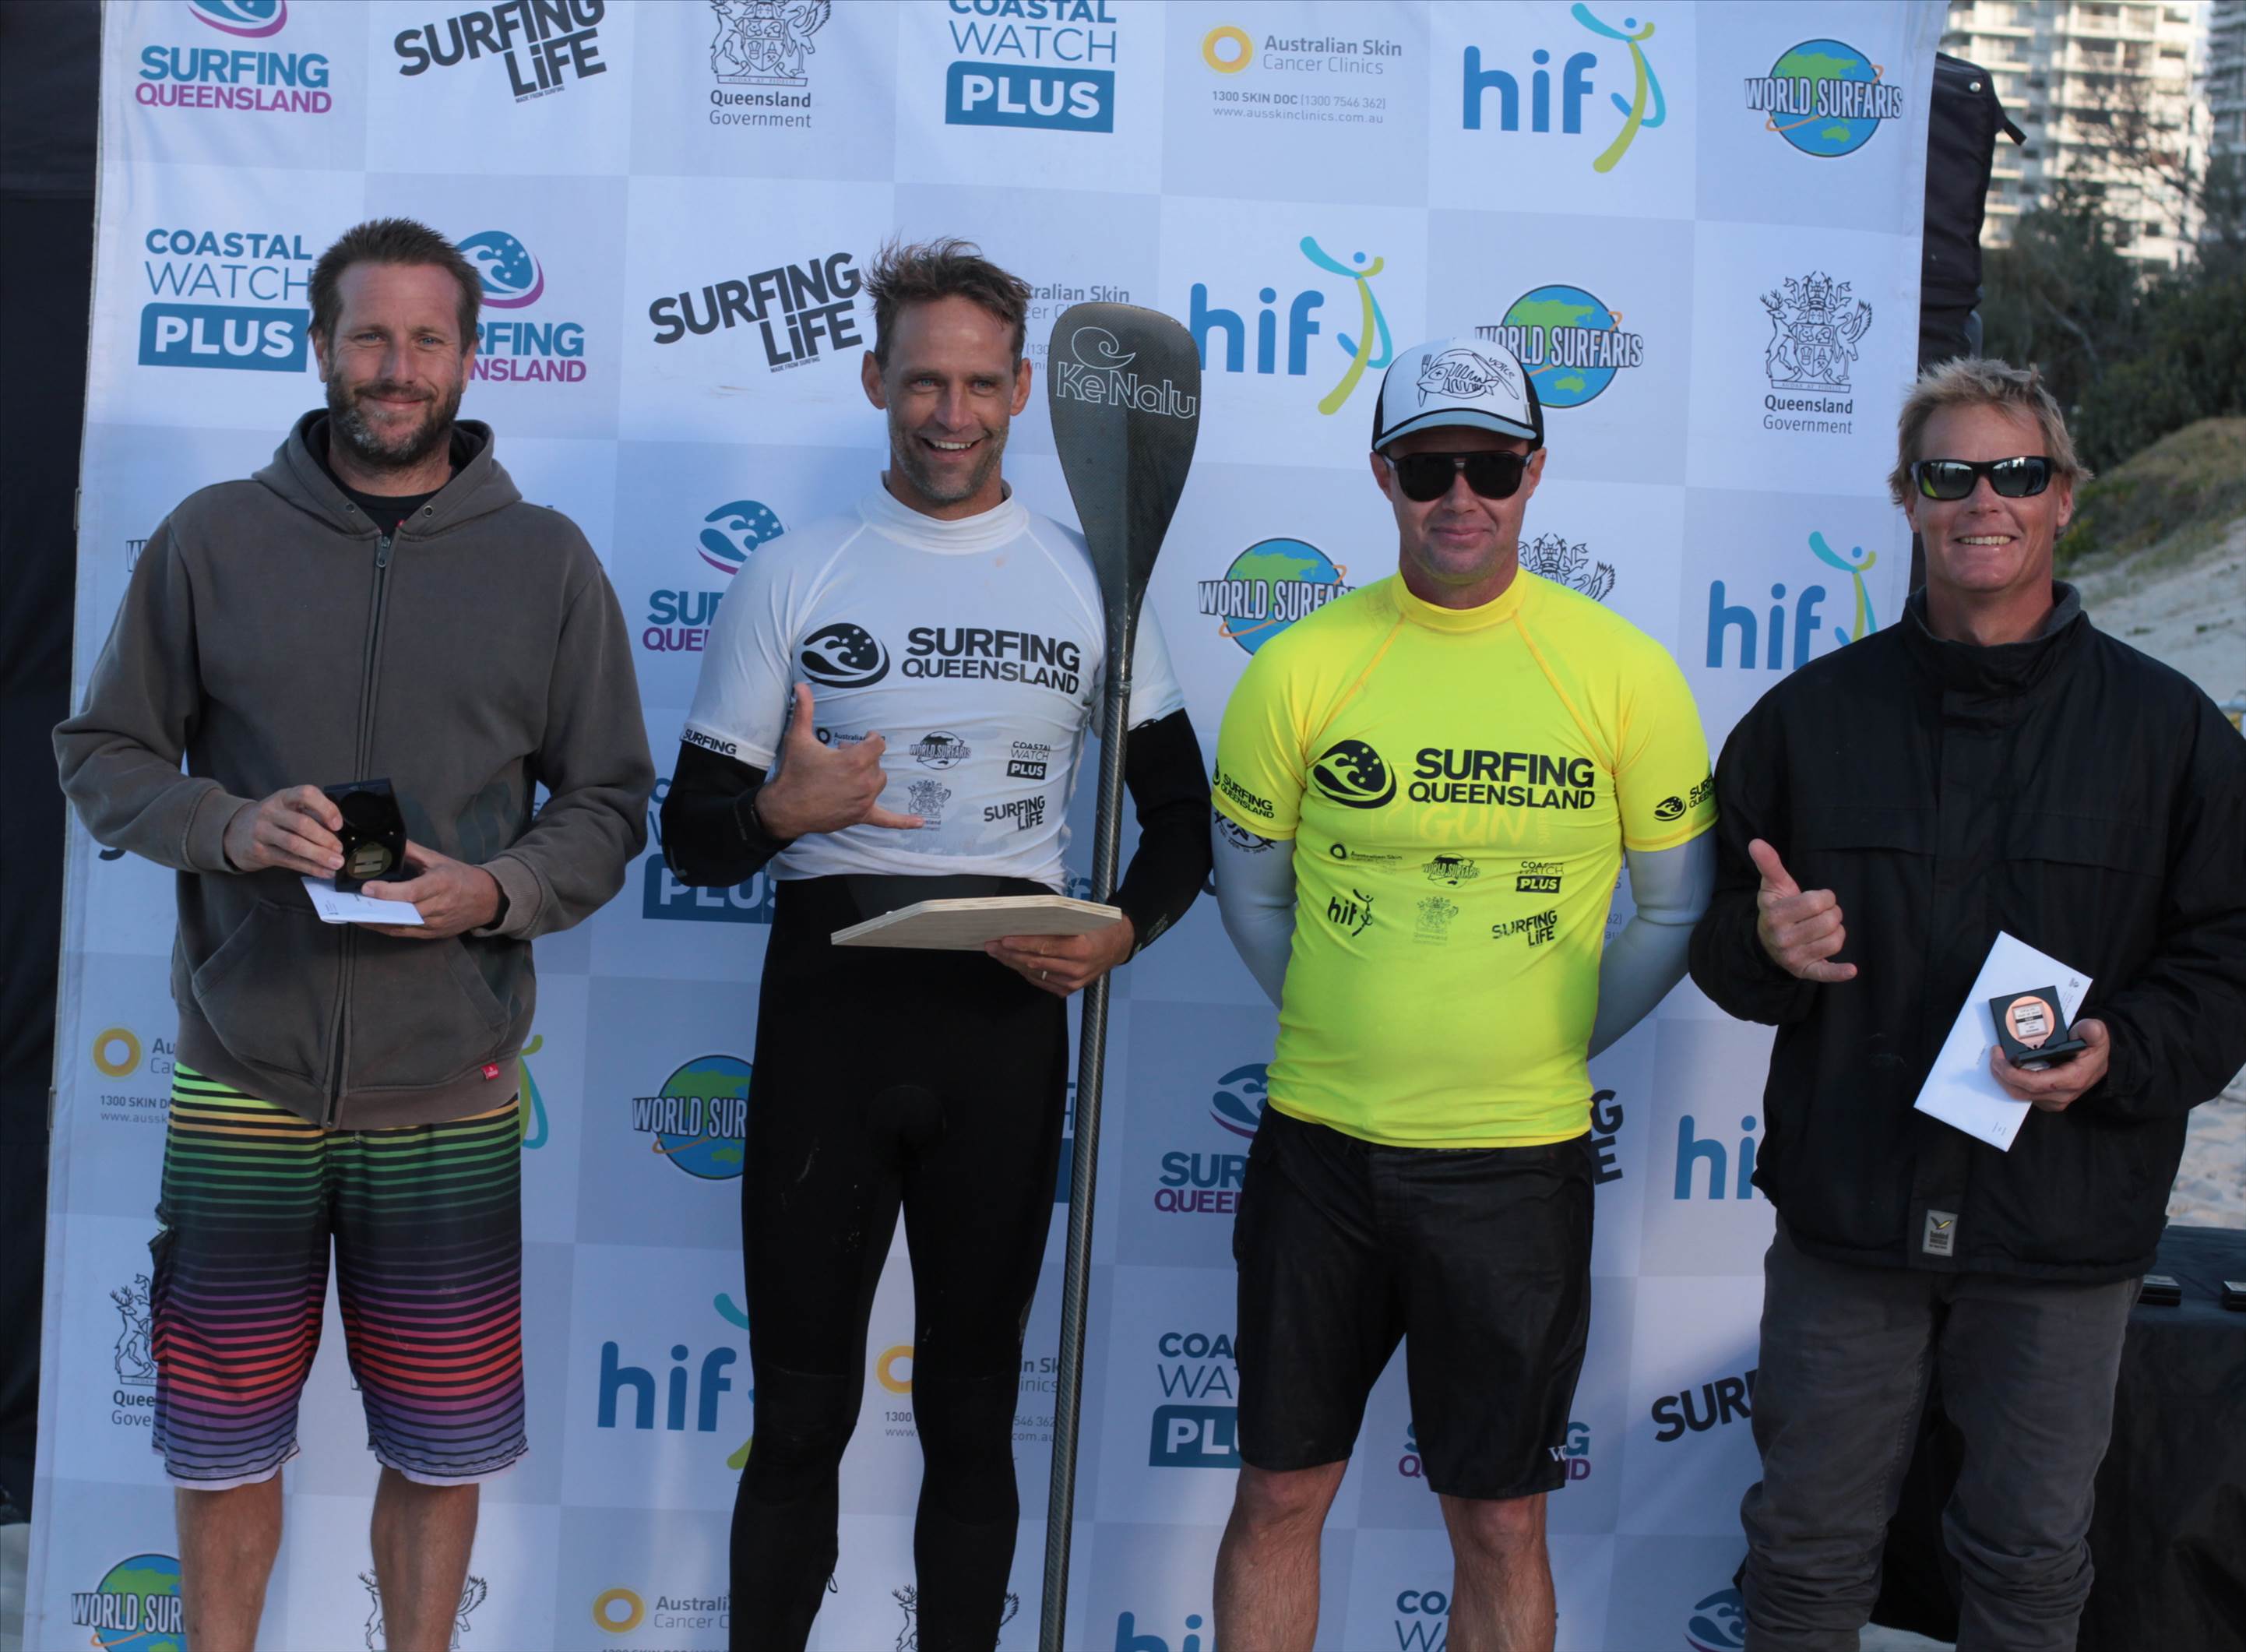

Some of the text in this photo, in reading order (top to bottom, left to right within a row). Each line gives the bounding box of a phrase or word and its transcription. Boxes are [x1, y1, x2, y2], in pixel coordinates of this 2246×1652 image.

[949, 0, 1117, 23] COASTAL
[394, 0, 605, 76] SURFING
[949, 20, 1116, 63] WATCH
[1264, 35, 1402, 56] Australian Skin
[139, 45, 329, 88] SURFING
[1263, 54, 1384, 75] Cancer Clinics
[136, 82, 333, 114] QUEENSLAND
[710, 90, 811, 107] Queensland
[962, 74, 1100, 118] PLUS
[1213, 90, 1239, 102] 1300
[1241, 92, 1271, 104] SKIN
[1273, 94, 1298, 104] DOC
[1333, 96, 1360, 108] 7546
[1744, 77, 1903, 119] WORLD SURFARIS
[709, 110, 812, 128] Government
[1213, 107, 1384, 124] www.ausskinclinics.com.au
[146, 228, 312, 260] COASTAL
[145, 261, 312, 301] WATCH
[1030, 284, 1130, 303] ralian Skin
[649, 252, 861, 344] SURFING
[155, 315, 294, 358] PLUS
[1550, 326, 1643, 368] SURFARIS
[1765, 394, 1853, 414] Queensland
[1763, 414, 1853, 434] Government
[1199, 579, 1269, 620] WORLD
[642, 627, 709, 652] QUE
[906, 627, 1080, 673] SURFING
[902, 658, 1079, 695] QUEENSLAND
[683, 728, 738, 755] SURFING
[910, 744, 972, 759] WORLD SURFARIS
[1011, 749, 1049, 761] WATCH
[1011, 763, 1044, 777] PLUS
[1413, 748, 1594, 788] SURFING
[1220, 783, 1275, 819] QUEENSLAND
[1223, 773, 1273, 811] SURFING
[1408, 781, 1595, 809] QUEENSLAND
[984, 795, 1045, 822] SURFING
[660, 868, 776, 909] PLU
[1519, 879, 1558, 890] PLUS
[1492, 910, 1558, 939] SURFING
[100, 1095, 126, 1106] 1300
[128, 1097, 157, 1108] SKIN
[632, 1097, 704, 1137] WORLD
[1157, 1364, 1238, 1399] WA
[885, 1411, 912, 1422] 1300
[1166, 1418, 1240, 1455] PL
[71, 1592, 139, 1632] WORLD
[656, 1596, 730, 1611] Australi
[654, 1614, 713, 1629] Cancer
